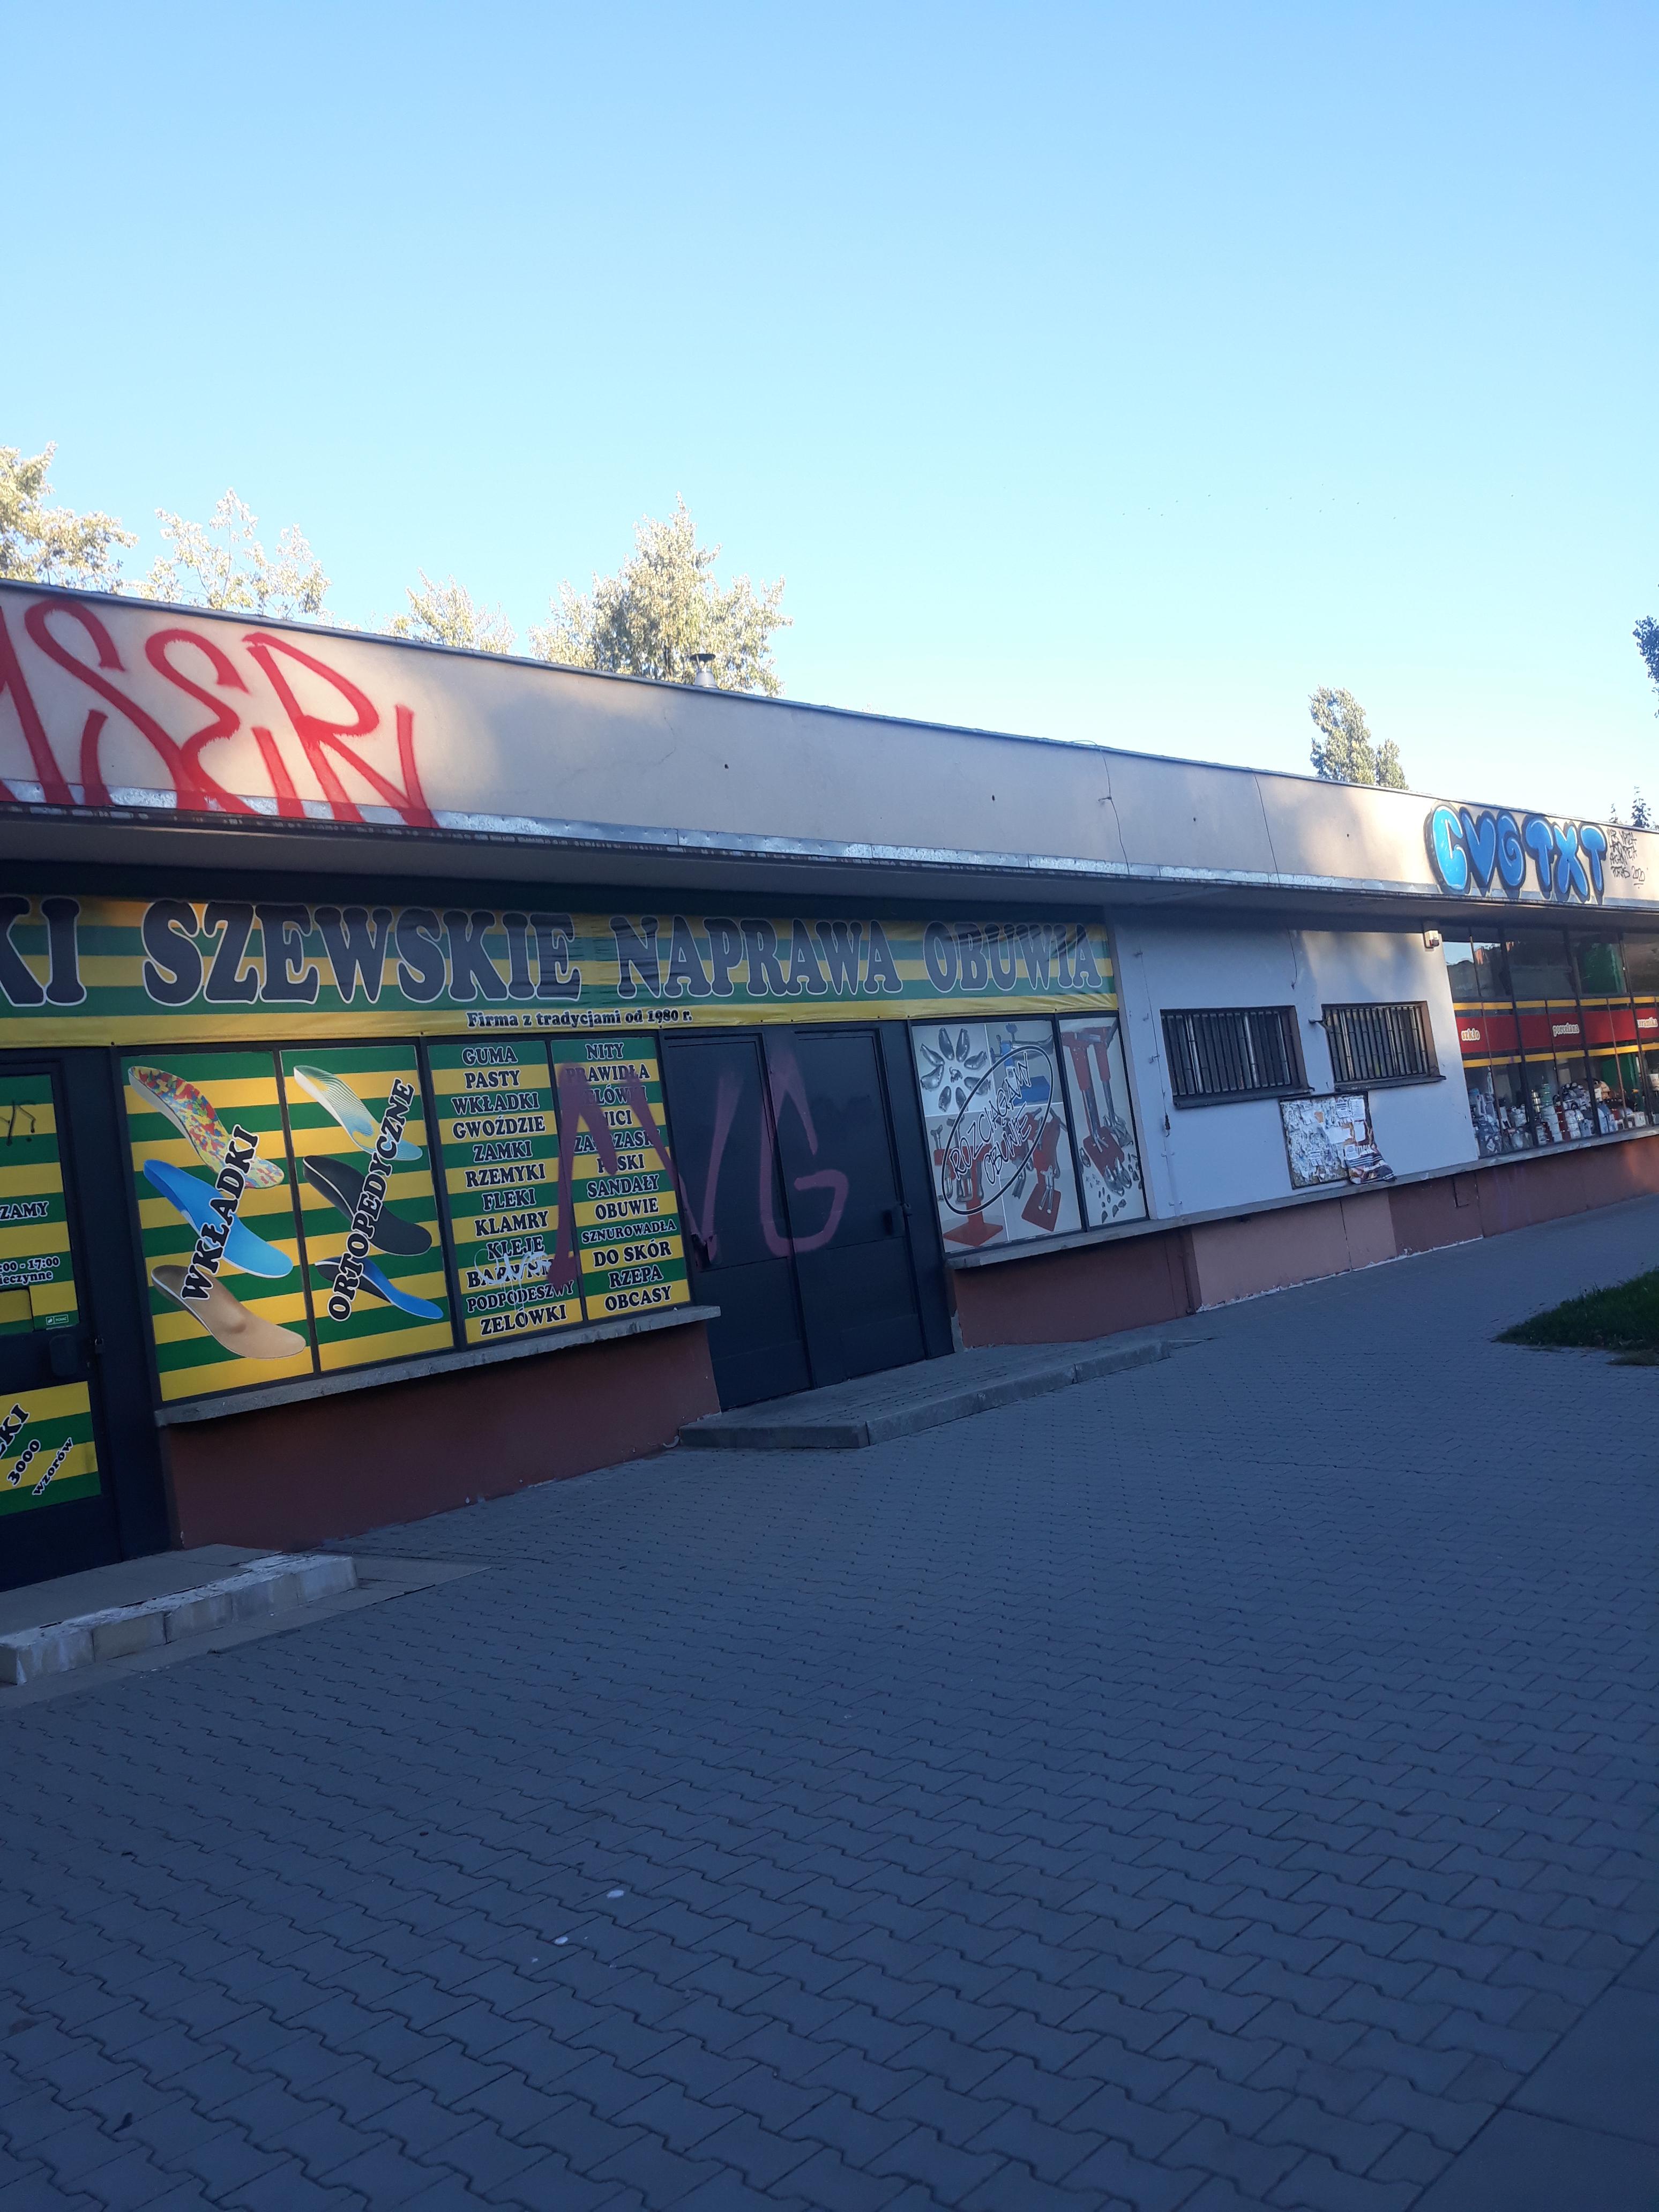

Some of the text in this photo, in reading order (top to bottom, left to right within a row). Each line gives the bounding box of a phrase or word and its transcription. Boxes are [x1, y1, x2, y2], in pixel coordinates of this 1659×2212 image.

[142, 899, 582, 1006] SZEWSKIE
[610, 914, 902, 998] NAPRAWA
[923, 920, 1103, 993] OBUWIA
[467, 1008, 693, 1028] Firma z tradycjami od 1980 r.
[1553, 1022, 1580, 1037] porcelana
[1638, 1017, 1658, 1028] eramika
[1461, 1028, 1481, 1041] szkło
[462, 1046, 518, 1066] GUMA
[585, 1042, 624, 1060] NITY
[465, 1070, 520, 1089] PASTY
[451, 1092, 540, 1116] WKŁADKI
[453, 1115, 545, 1140] GWOŹDZIE
[473, 1139, 533, 1163] ZAMKI
[983, 1101, 1032, 1186] OBUWIE
[465, 1162, 546, 1188] RZEMYKI
[596, 1153, 645, 1174] PSKI
[587, 1174, 660, 1198] SANDAŁY
[327, 1078, 415, 1321] ORTOPEDYCZNE
[482, 1186, 536, 1212] FLEKI
[594, 1197, 659, 1221] OBUWIE
[181, 1124, 259, 1300] WKŁADKI
[474, 1209, 549, 1237] KLAMRY
[581, 1219, 676, 1244] SZNUROWADŁA
[487, 1235, 544, 1260] KLEJE
[593, 1239, 672, 1268] DO SKÓR
[27, 1256, 60, 1271] 17:00
[608, 1265, 664, 1289] RZEPA
[604, 1285, 672, 1312] OBCASY
[480, 1304, 567, 1336] ZELÓWKI
[7, 1439, 41, 1486] 3000
[32, 1437, 73, 1495] wzorów
